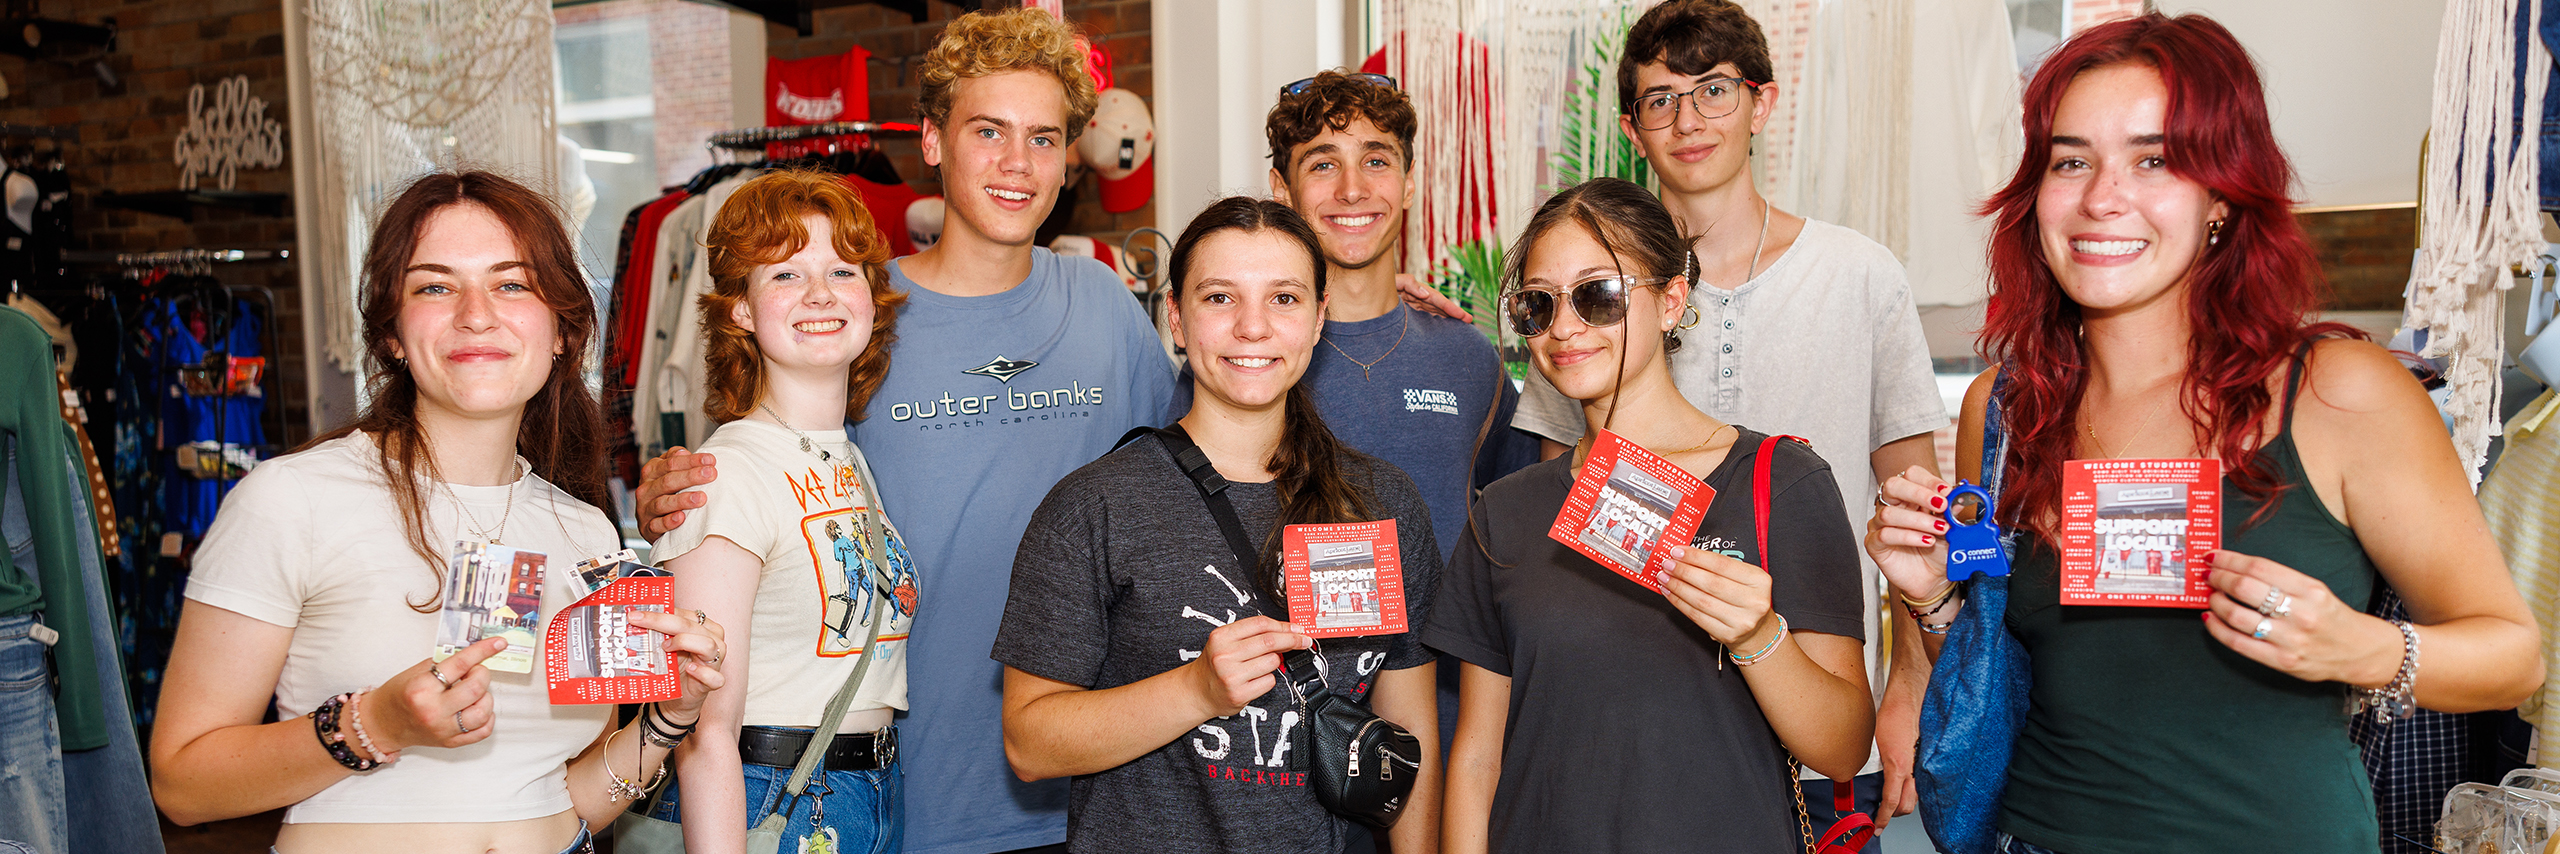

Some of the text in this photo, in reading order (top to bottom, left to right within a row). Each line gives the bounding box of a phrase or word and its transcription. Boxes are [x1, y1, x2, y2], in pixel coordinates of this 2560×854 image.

[185, 75, 269, 140] hello
[174, 118, 283, 191] gorgeous
[890, 380, 1103, 422] outer banks
[1414, 388, 1446, 404] VANS
[920, 410, 1090, 432] north carolina
[1615, 436, 1653, 461] WELCOME
[784, 466, 832, 514] DEF
[1598, 484, 1670, 533] SUPPORT
[1600, 501, 1654, 540] LOCAL!
[2094, 518, 2190, 535] SUPPORT
[1722, 540, 1737, 548] OF
[2105, 535, 2177, 551] LOCAL!
[1310, 568, 1377, 583] SUPPORT
[1319, 580, 1370, 594] LOCAL!
[599, 604, 615, 678] SUPPORT
[613, 613, 628, 669] LOCAL!
[548, 648, 556, 689] WELCOME
[1208, 764, 1306, 786] BACK THE
